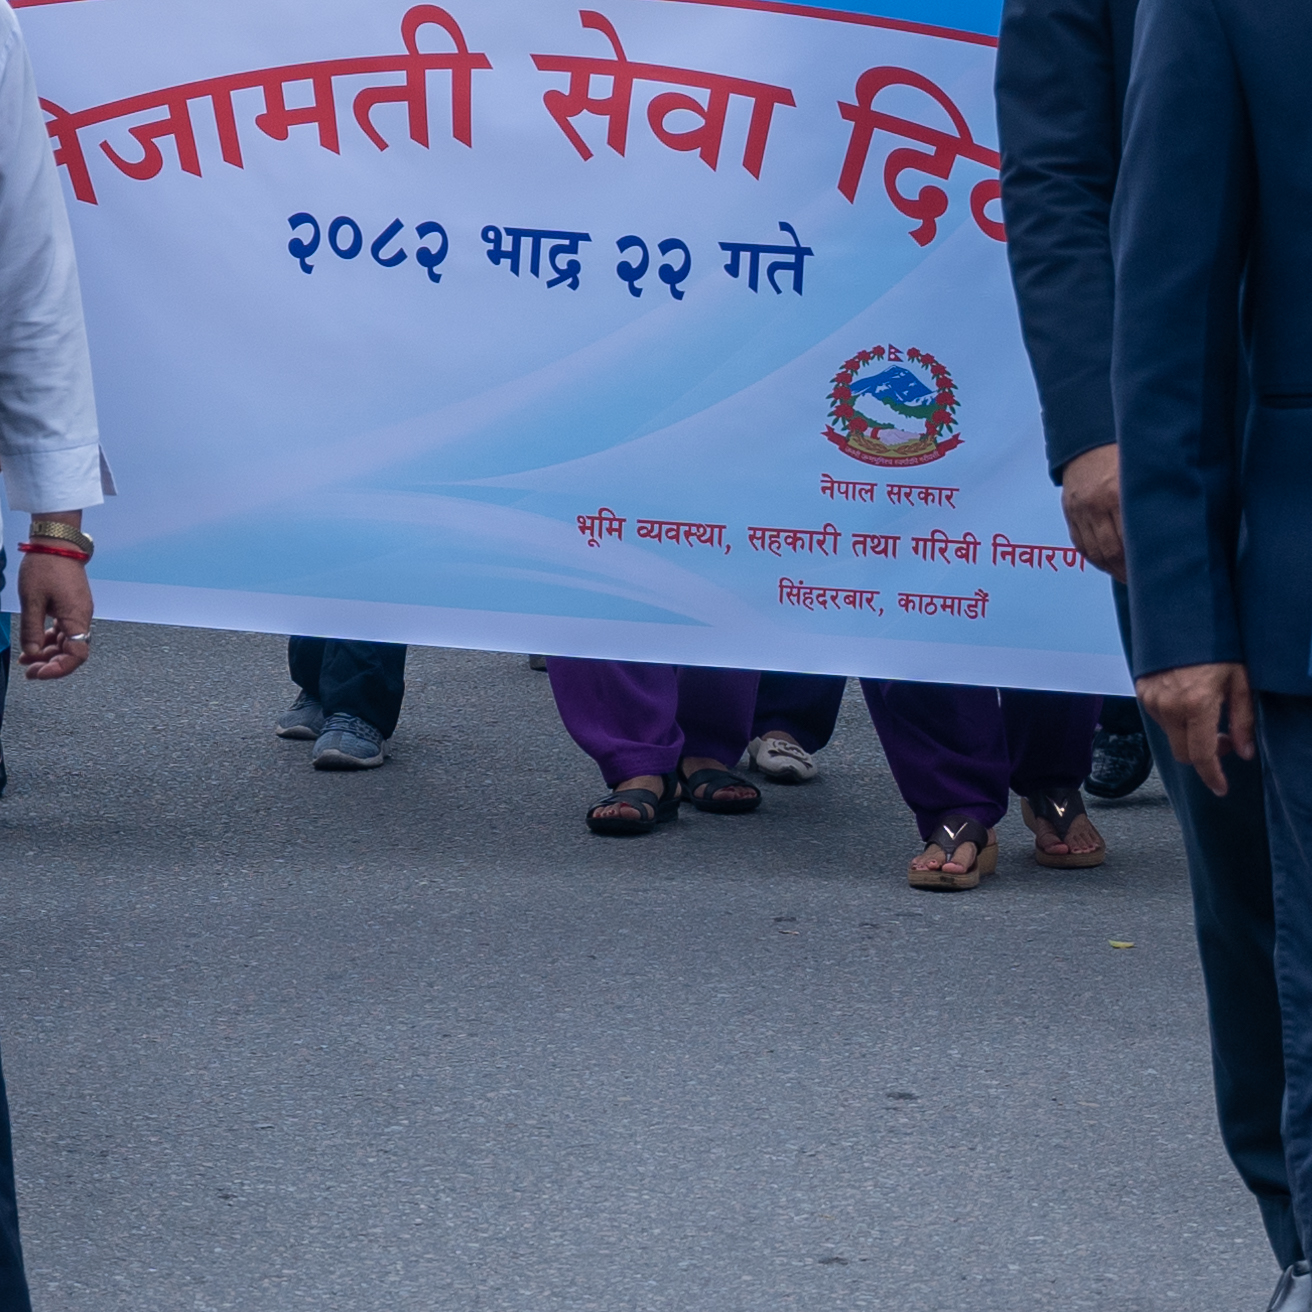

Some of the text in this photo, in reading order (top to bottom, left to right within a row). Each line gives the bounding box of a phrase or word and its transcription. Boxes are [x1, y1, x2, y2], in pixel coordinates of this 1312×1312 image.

[529, 9, 797, 181] सेवा
[287, 211, 814, 301] २०८२ भाद्र २२ गते
[820, 473, 960, 510] नेपाल सरकार
[576, 507, 1087, 573] भूमि व्यवस्था, सहकारी तथा गरिबी निवारण
[778, 577, 884, 617] सिंहदरबार,
